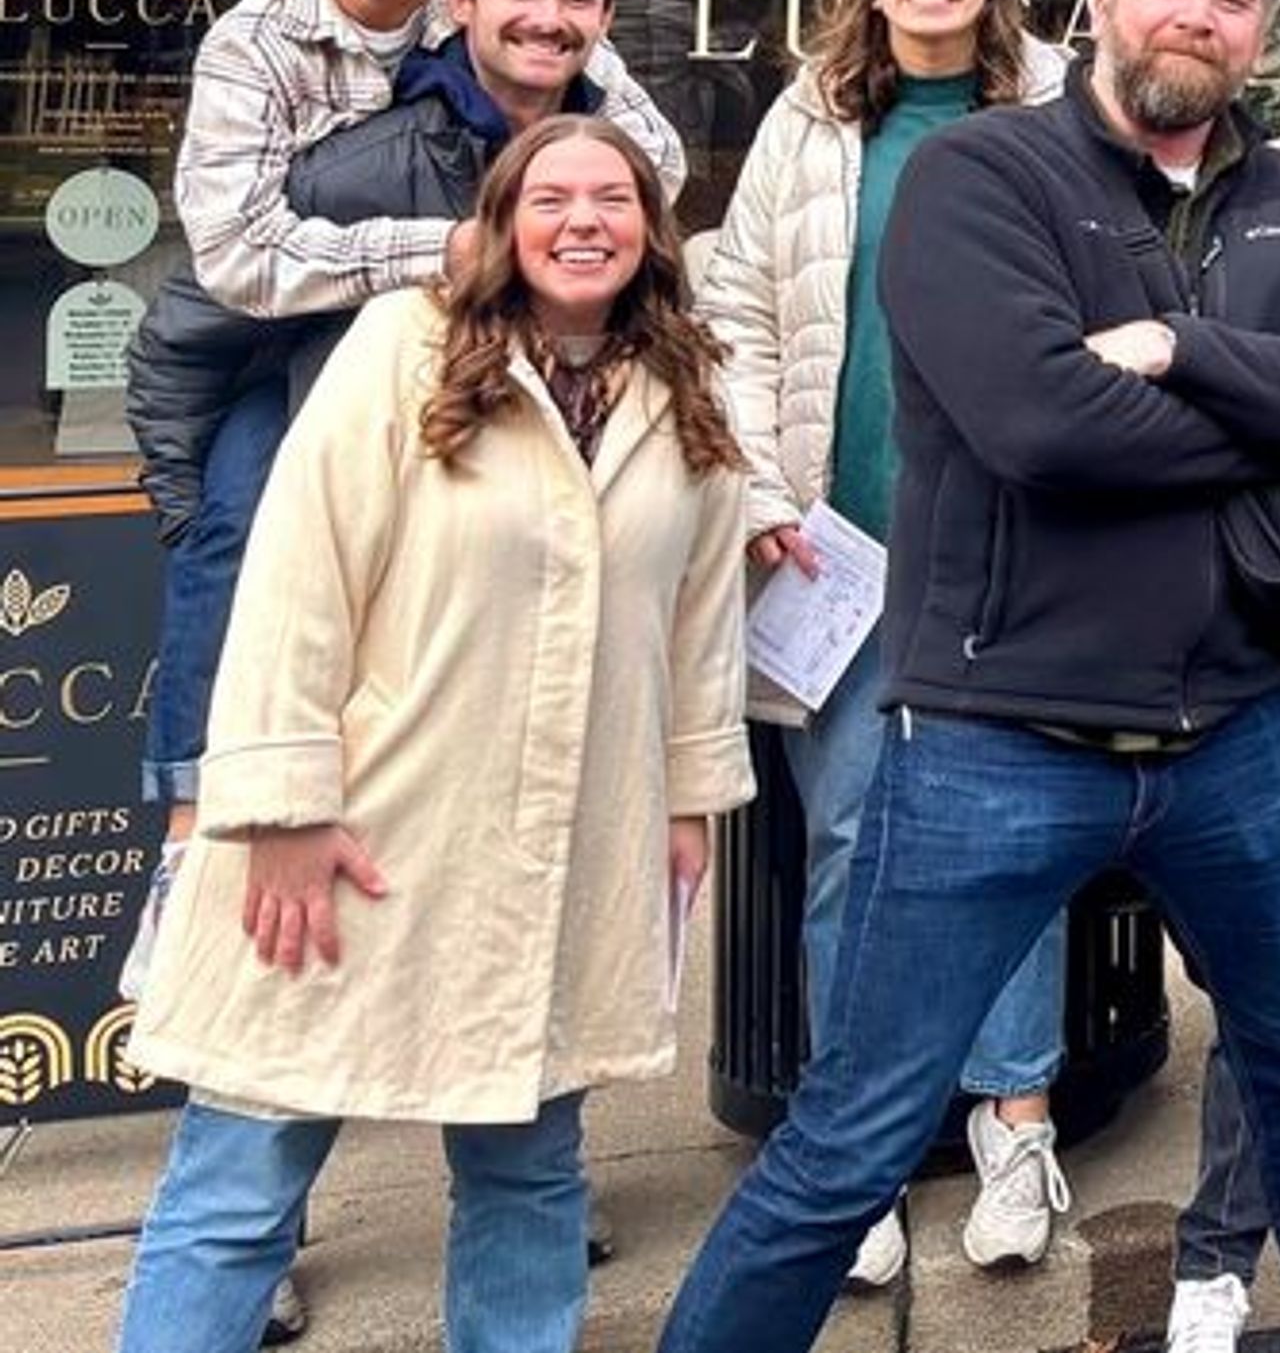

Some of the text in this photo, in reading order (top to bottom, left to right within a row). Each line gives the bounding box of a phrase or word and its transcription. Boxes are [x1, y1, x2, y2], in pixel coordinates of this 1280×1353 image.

[56, 204, 147, 231] OPEN
[25, 807, 130, 841] GIFTS
[16, 848, 145, 883] DECOR
[32, 933, 105, 965] ART
